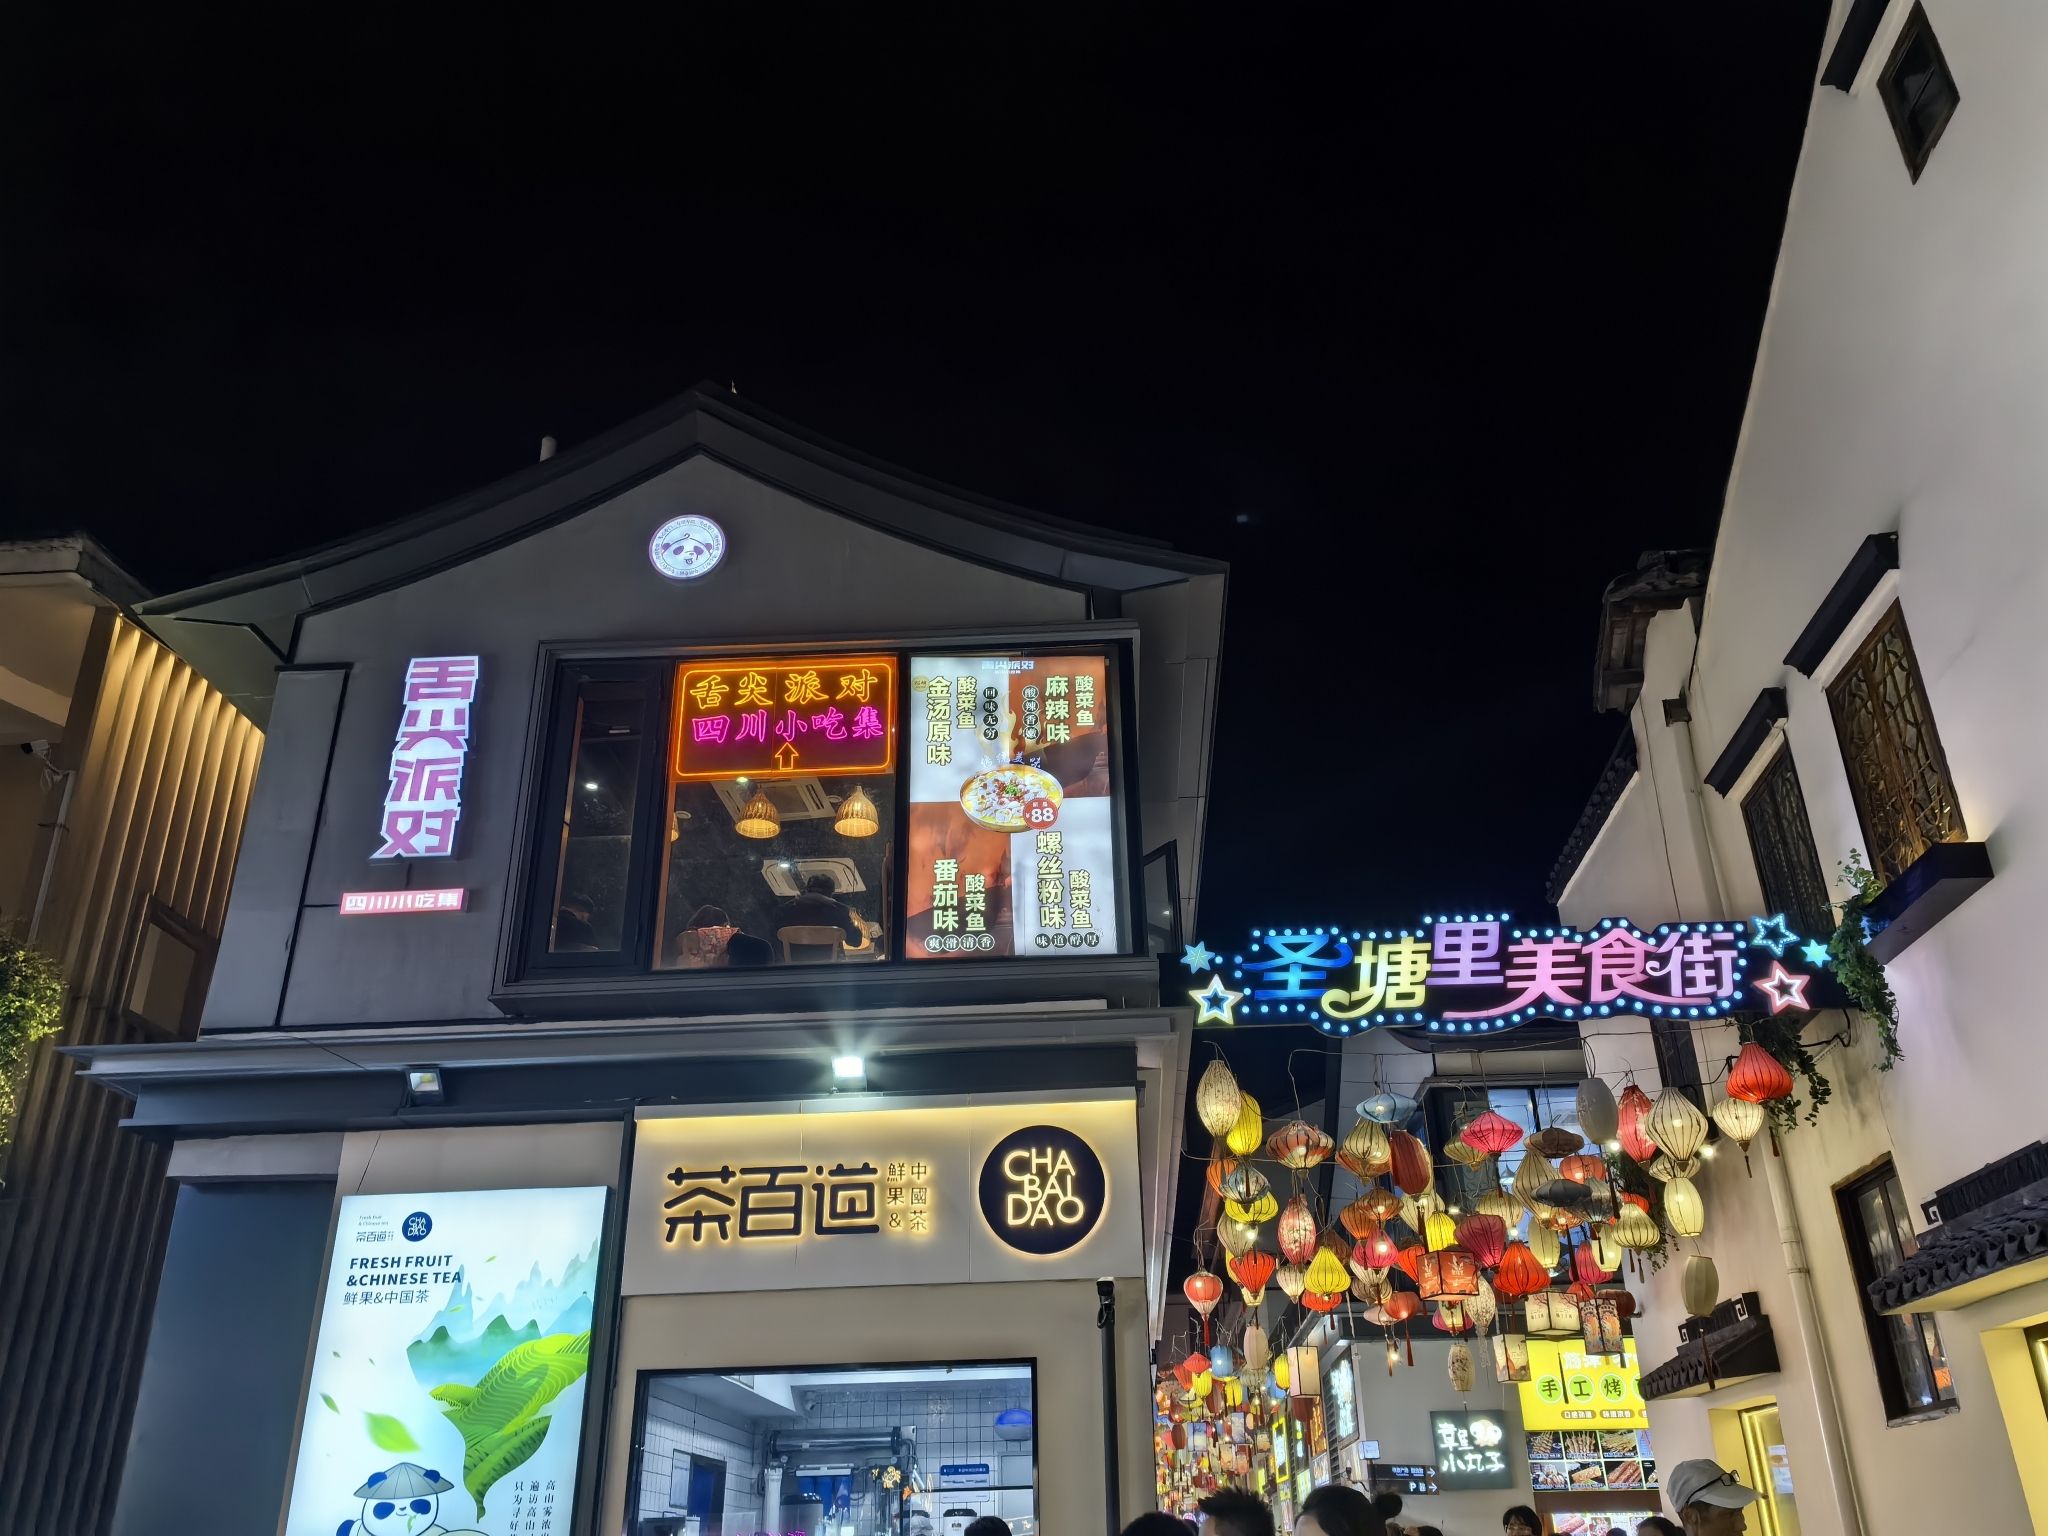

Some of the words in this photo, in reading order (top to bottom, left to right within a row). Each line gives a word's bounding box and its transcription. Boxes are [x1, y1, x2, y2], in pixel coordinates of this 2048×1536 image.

[689, 668, 879, 710] 舌尖派对
[956, 675, 977, 729] 酸菜鱼
[1074, 675, 1095, 726] 酸菜鱼
[691, 706, 884, 744] 四川小吃集
[926, 675, 952, 766] 金汤原味
[983, 686, 999, 740] 回味无穷
[1045, 675, 1071, 744] 麻辣味
[378, 657, 478, 857] 舌尖派对
[933, 859, 958, 932] 番茄味
[1036, 831, 1065, 929] 螺丝粉味
[345, 892, 459, 911] 四川小吃集
[965, 874, 986, 931] 酸菜鱼
[1069, 870, 1092, 929] 酸菜鱼
[926, 936, 994, 950] 爽滑清香
[1035, 933, 1099, 948] 味道醇厚
[1243, 920, 1738, 1018] 圣塘里美食街
[1003, 1147, 1076, 1182] CHA
[663, 1161, 880, 1243] 茶百道
[1023, 1174, 1074, 1201] BAI
[408, 1217, 426, 1225] CHA
[1007, 1193, 1084, 1227] DAO
[408, 1228, 427, 1236] DAO
[346, 1273, 429, 1287] &CHINESE
[433, 1271, 462, 1284] TEA
[350, 1257, 402, 1270] FRESH
[405, 1255, 453, 1268] FRUIT
[343, 1289, 430, 1306] 鲜果&中国茶
[1541, 1378, 1641, 1398] 手工烤
[1437, 1422, 1474, 1451] 章鱼
[1441, 1452, 1505, 1472] 小丸子
